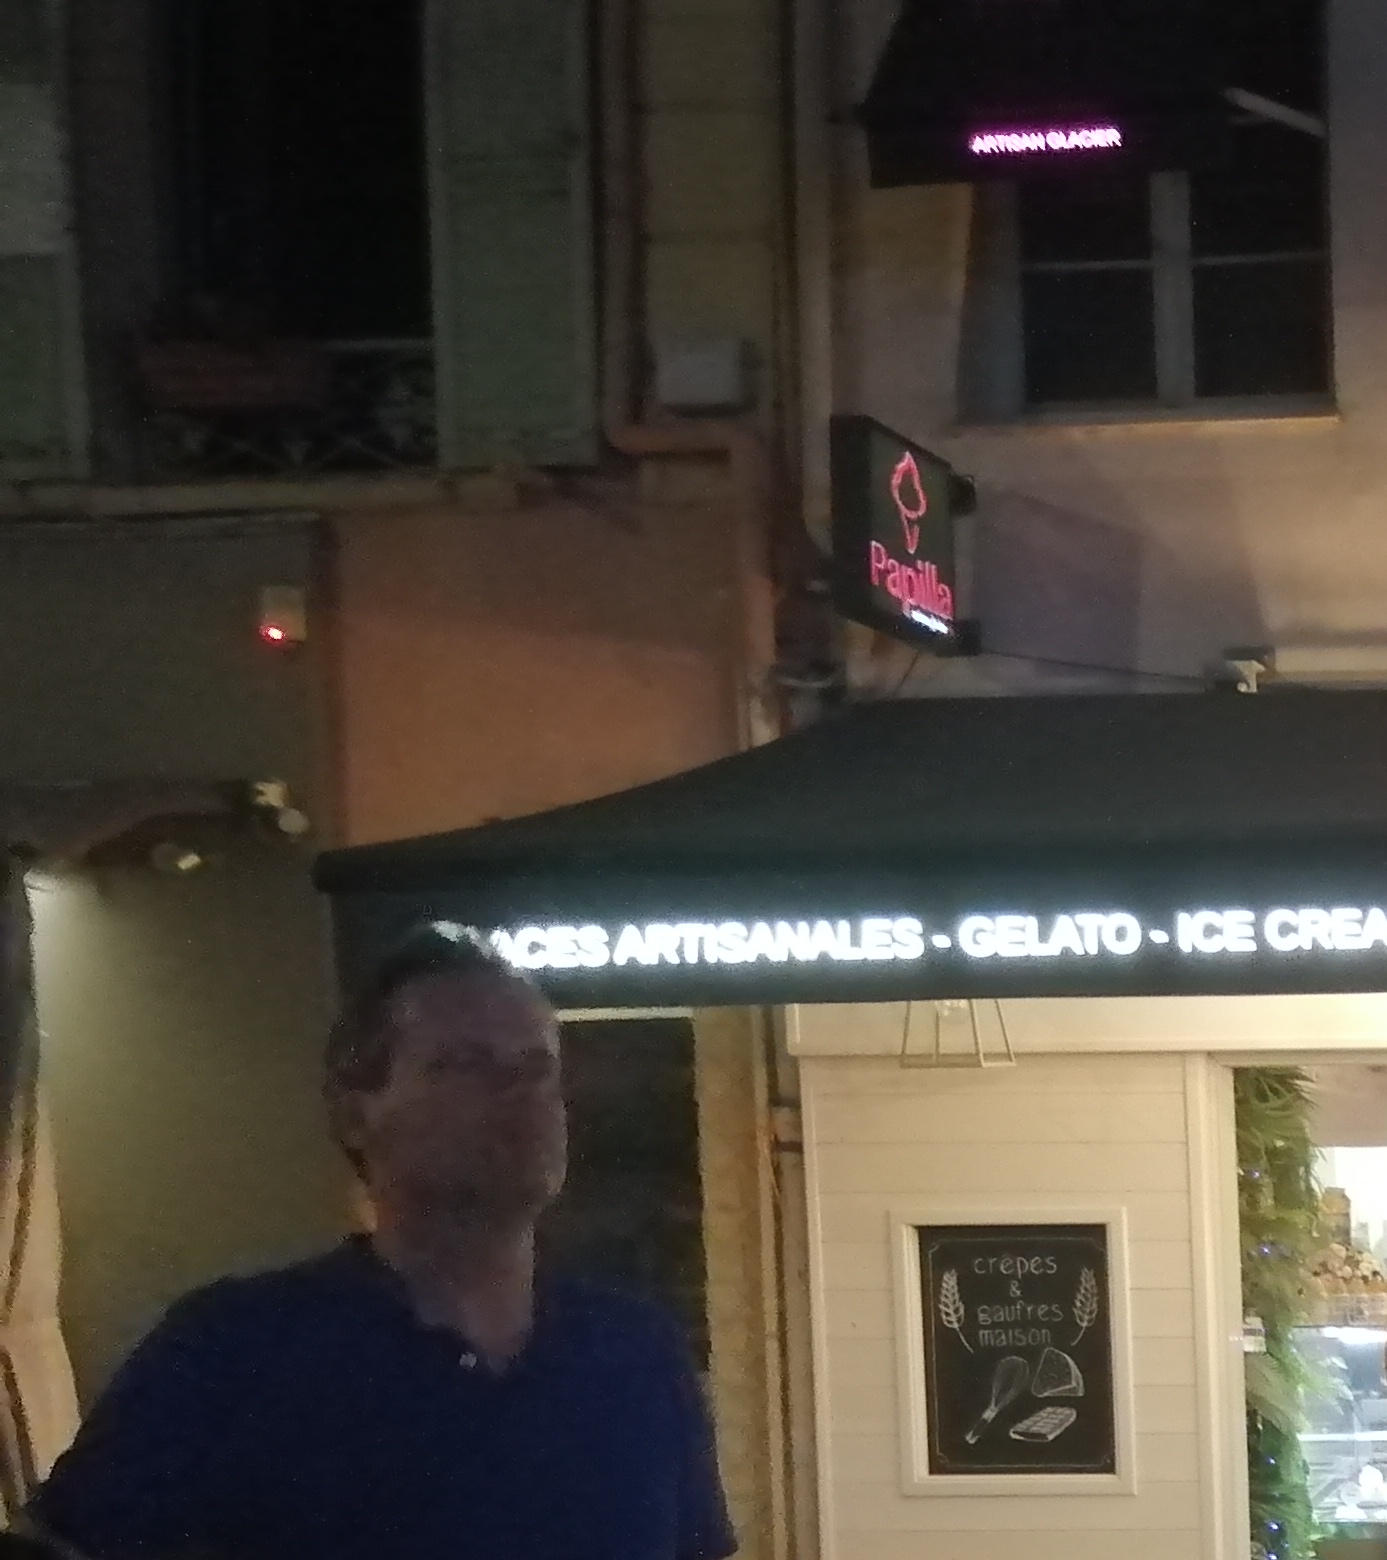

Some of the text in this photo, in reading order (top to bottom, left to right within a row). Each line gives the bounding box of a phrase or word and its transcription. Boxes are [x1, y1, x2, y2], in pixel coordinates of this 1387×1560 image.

[869, 540, 953, 620] Papilla
[612, 918, 924, 967] ARTISANALES
[958, 912, 1142, 958] GELATO
[1177, 909, 1259, 953] ICE
[1009, 1280, 1022, 1298] &
[977, 1300, 1064, 1325] gaufres
[979, 1328, 1051, 1347] maison
